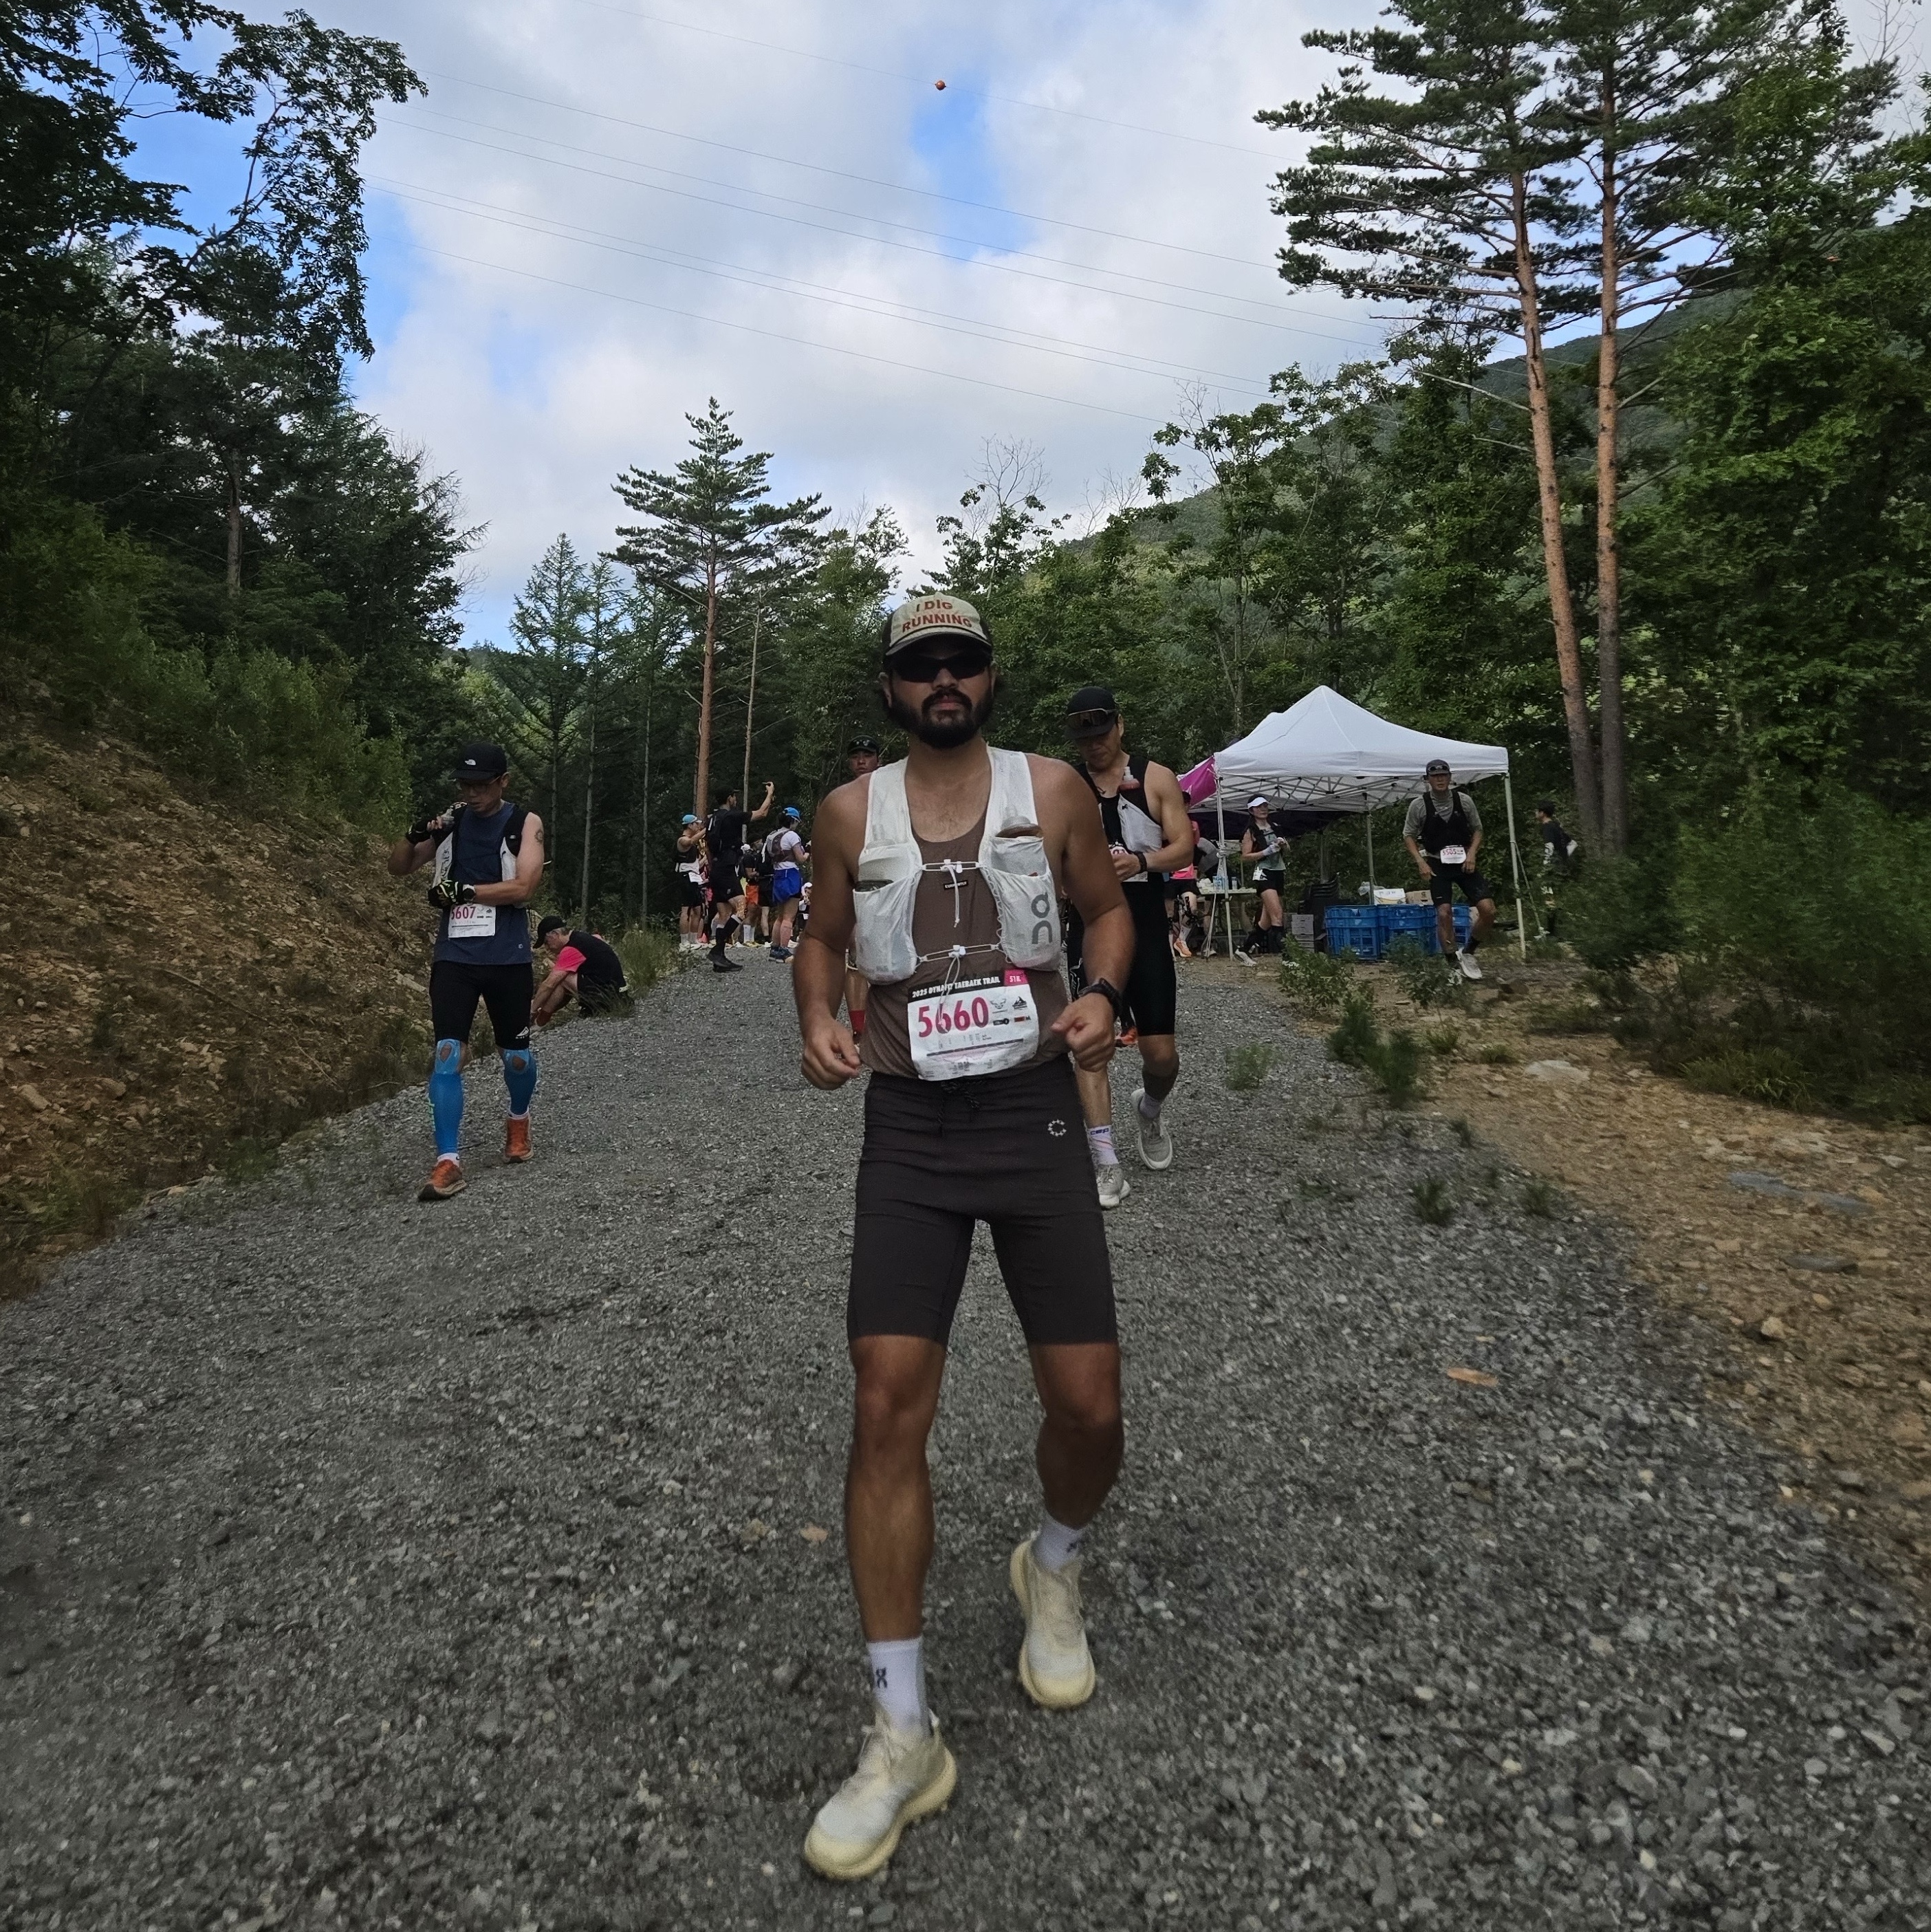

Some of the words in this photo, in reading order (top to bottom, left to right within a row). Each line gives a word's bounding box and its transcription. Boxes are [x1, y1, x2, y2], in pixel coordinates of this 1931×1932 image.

[916, 604, 920, 612] I
[924, 600, 952, 610] DIG
[902, 614, 972, 633] RUNNING
[451, 906, 476, 920] 5607
[912, 988, 928, 998] 2025
[954, 979, 982, 989] TAEBAEK
[983, 976, 1001, 985] TRAIL
[918, 997, 989, 1038] 5660
